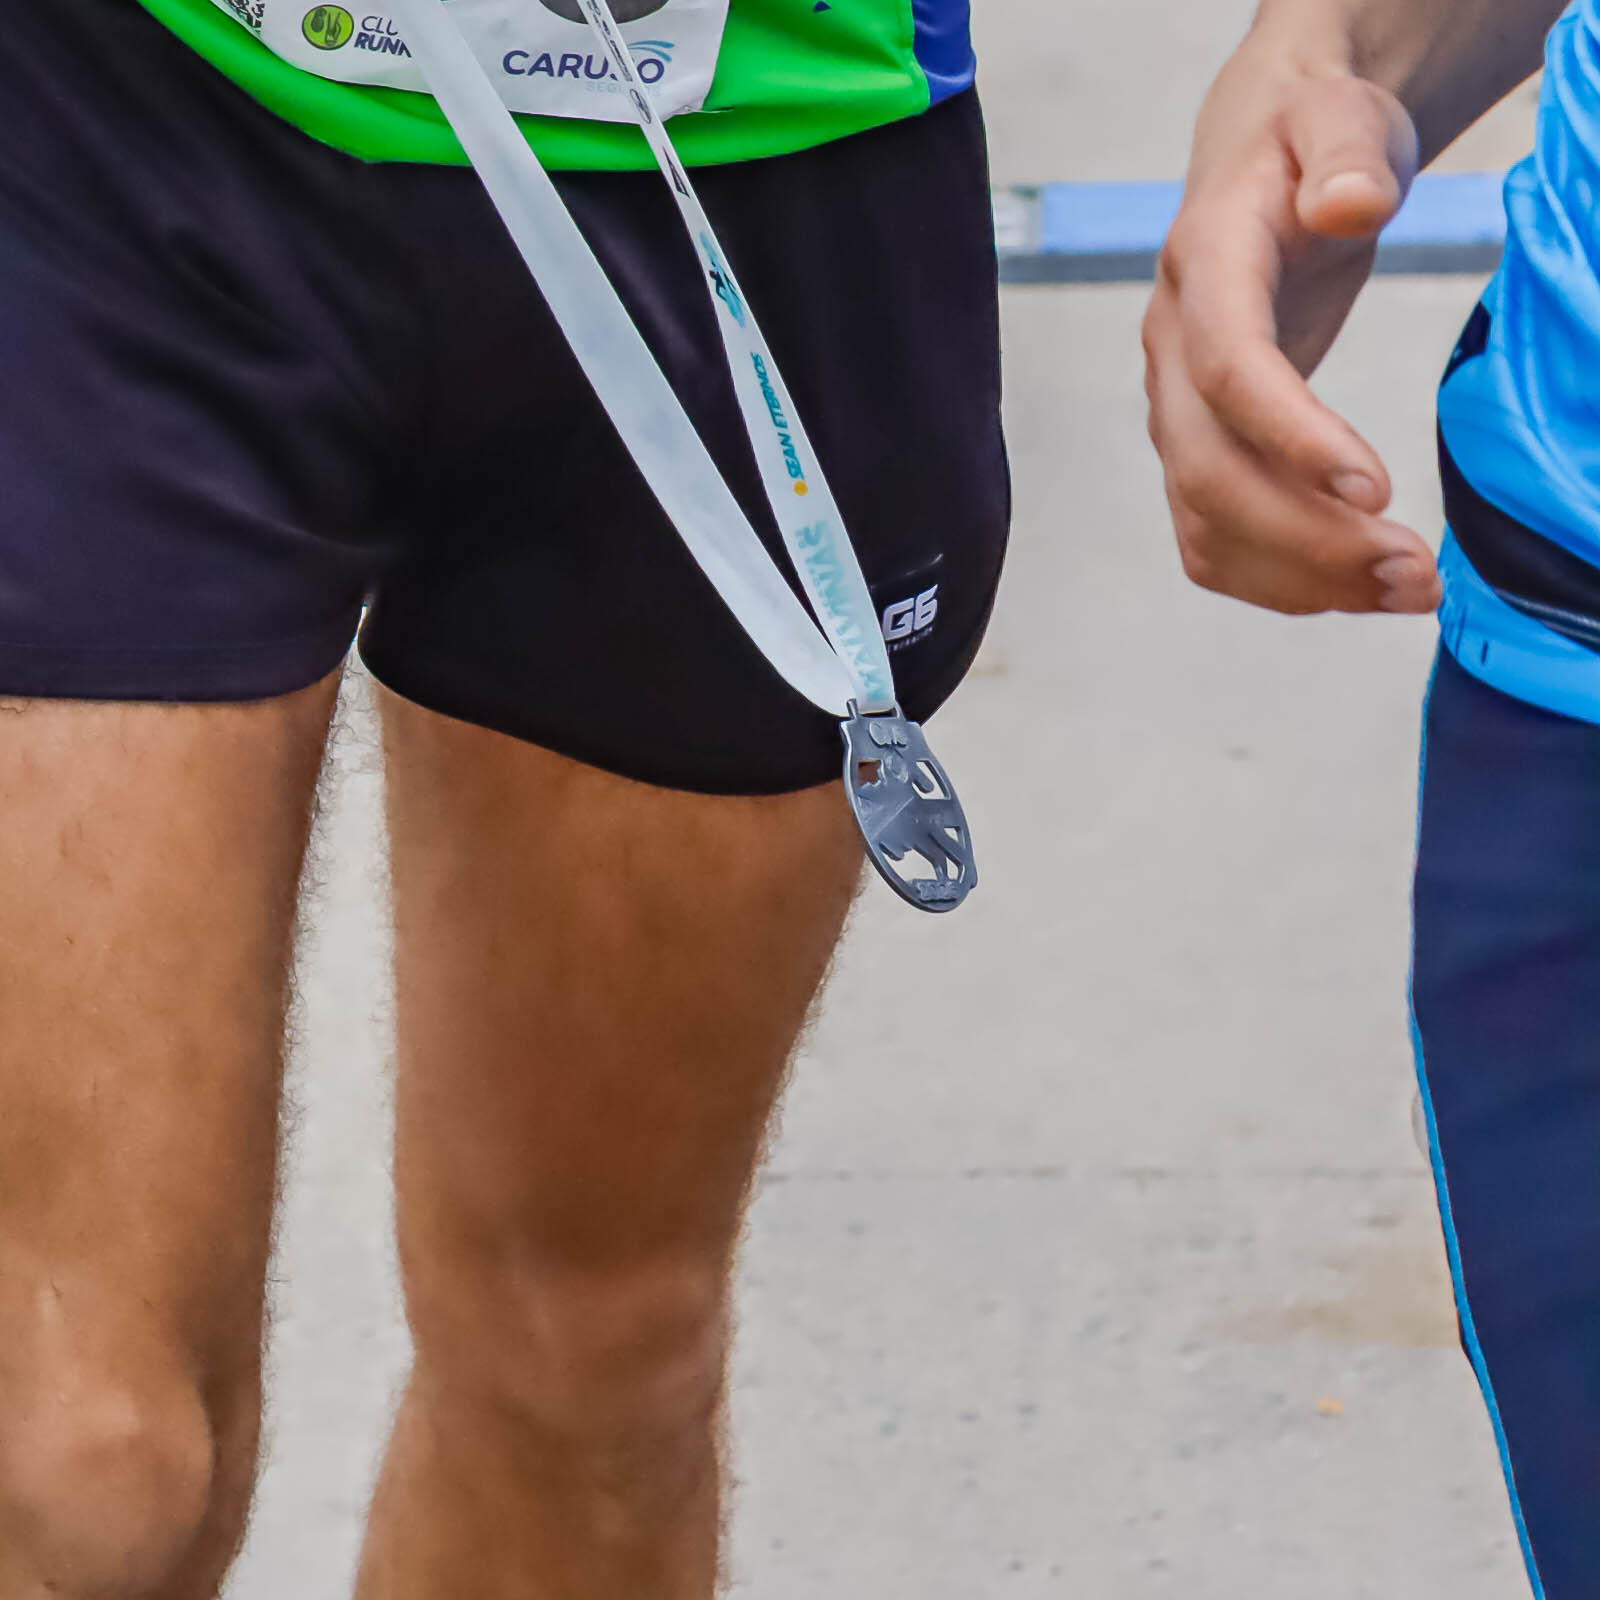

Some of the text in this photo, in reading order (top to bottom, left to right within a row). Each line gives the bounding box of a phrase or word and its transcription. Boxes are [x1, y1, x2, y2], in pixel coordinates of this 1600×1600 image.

[503, 50, 665, 84] CARUO
[751, 352, 806, 480] SEAN ETERNOS
